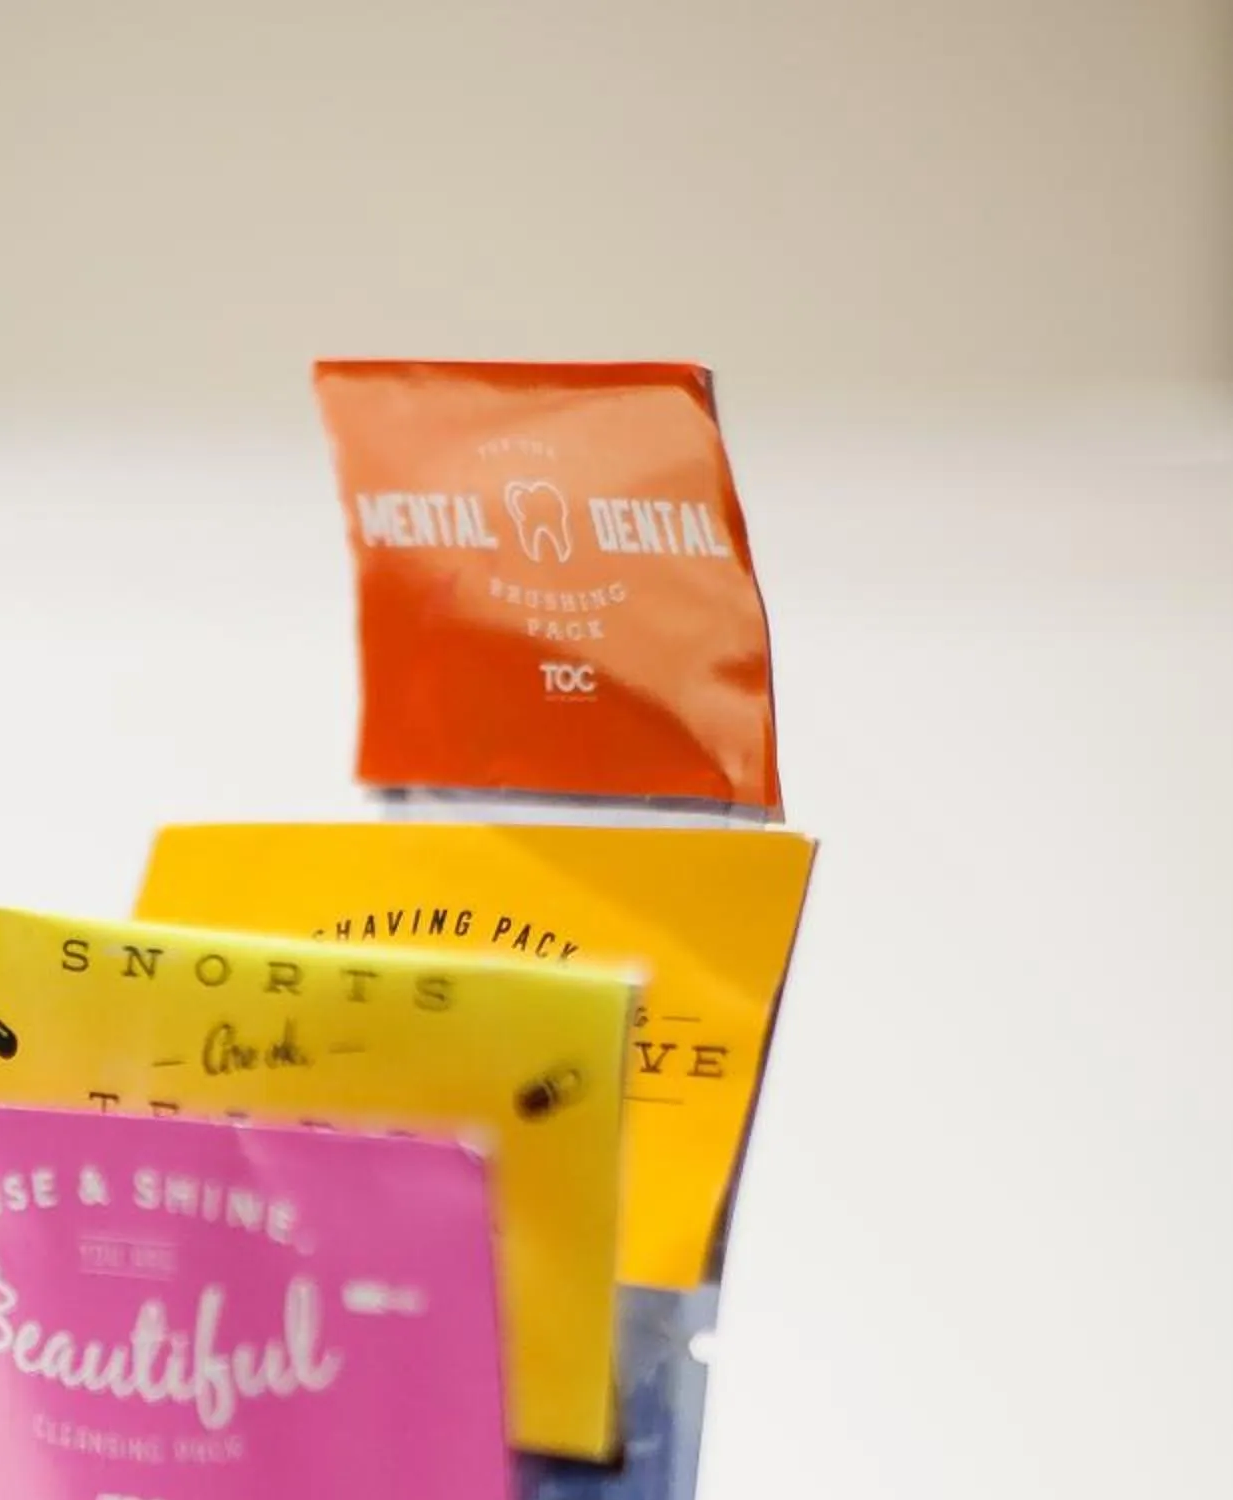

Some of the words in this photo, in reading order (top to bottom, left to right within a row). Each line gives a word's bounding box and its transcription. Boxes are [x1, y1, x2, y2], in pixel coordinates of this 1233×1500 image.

[356, 493, 499, 548] MENTAL
[587, 497, 732, 557] DENTAL
[489, 576, 627, 613] BRUSHING
[526, 617, 605, 641] PACK
[538, 662, 596, 692] TOC
[491, 916, 579, 967] PACK
[62, 938, 457, 1013] SNORTS
[79, 1163, 111, 1206] &
